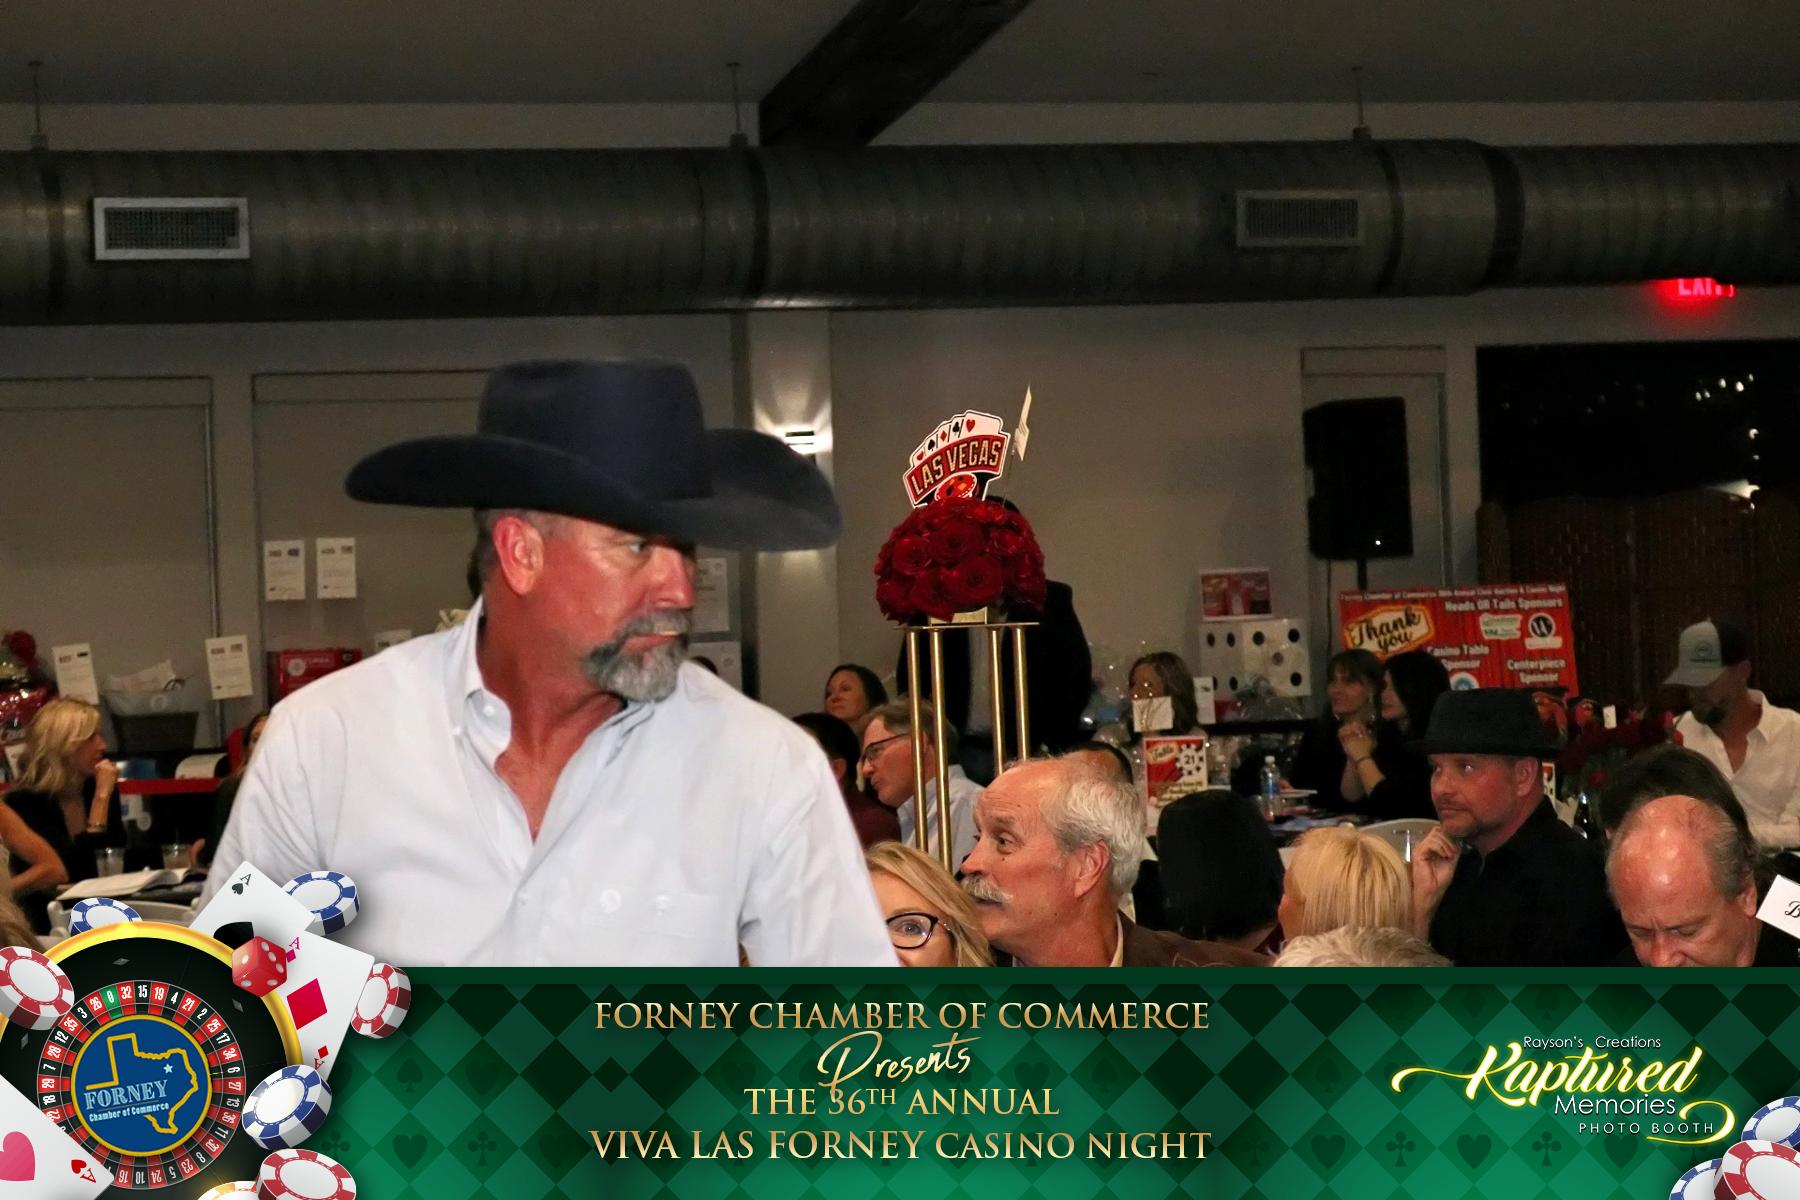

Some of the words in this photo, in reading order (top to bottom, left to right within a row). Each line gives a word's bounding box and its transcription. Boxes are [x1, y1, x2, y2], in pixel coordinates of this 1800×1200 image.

[911, 455, 943, 496] LAS
[947, 440, 1001, 472] VEGAS
[1445, 601, 1475, 611] Heads
[1476, 599, 1490, 610] OR
[1491, 599, 1517, 610] Tails
[1518, 598, 1562, 610] Sponsors
[1346, 606, 1420, 647] Thank
[1378, 632, 1413, 655] you
[1462, 644, 1489, 655] Table
[1427, 645, 1460, 656] Casino
[1441, 659, 1480, 671] Sponsor
[1507, 658, 1566, 671] Centerpiece
[1184, 754, 1195, 765] 21
